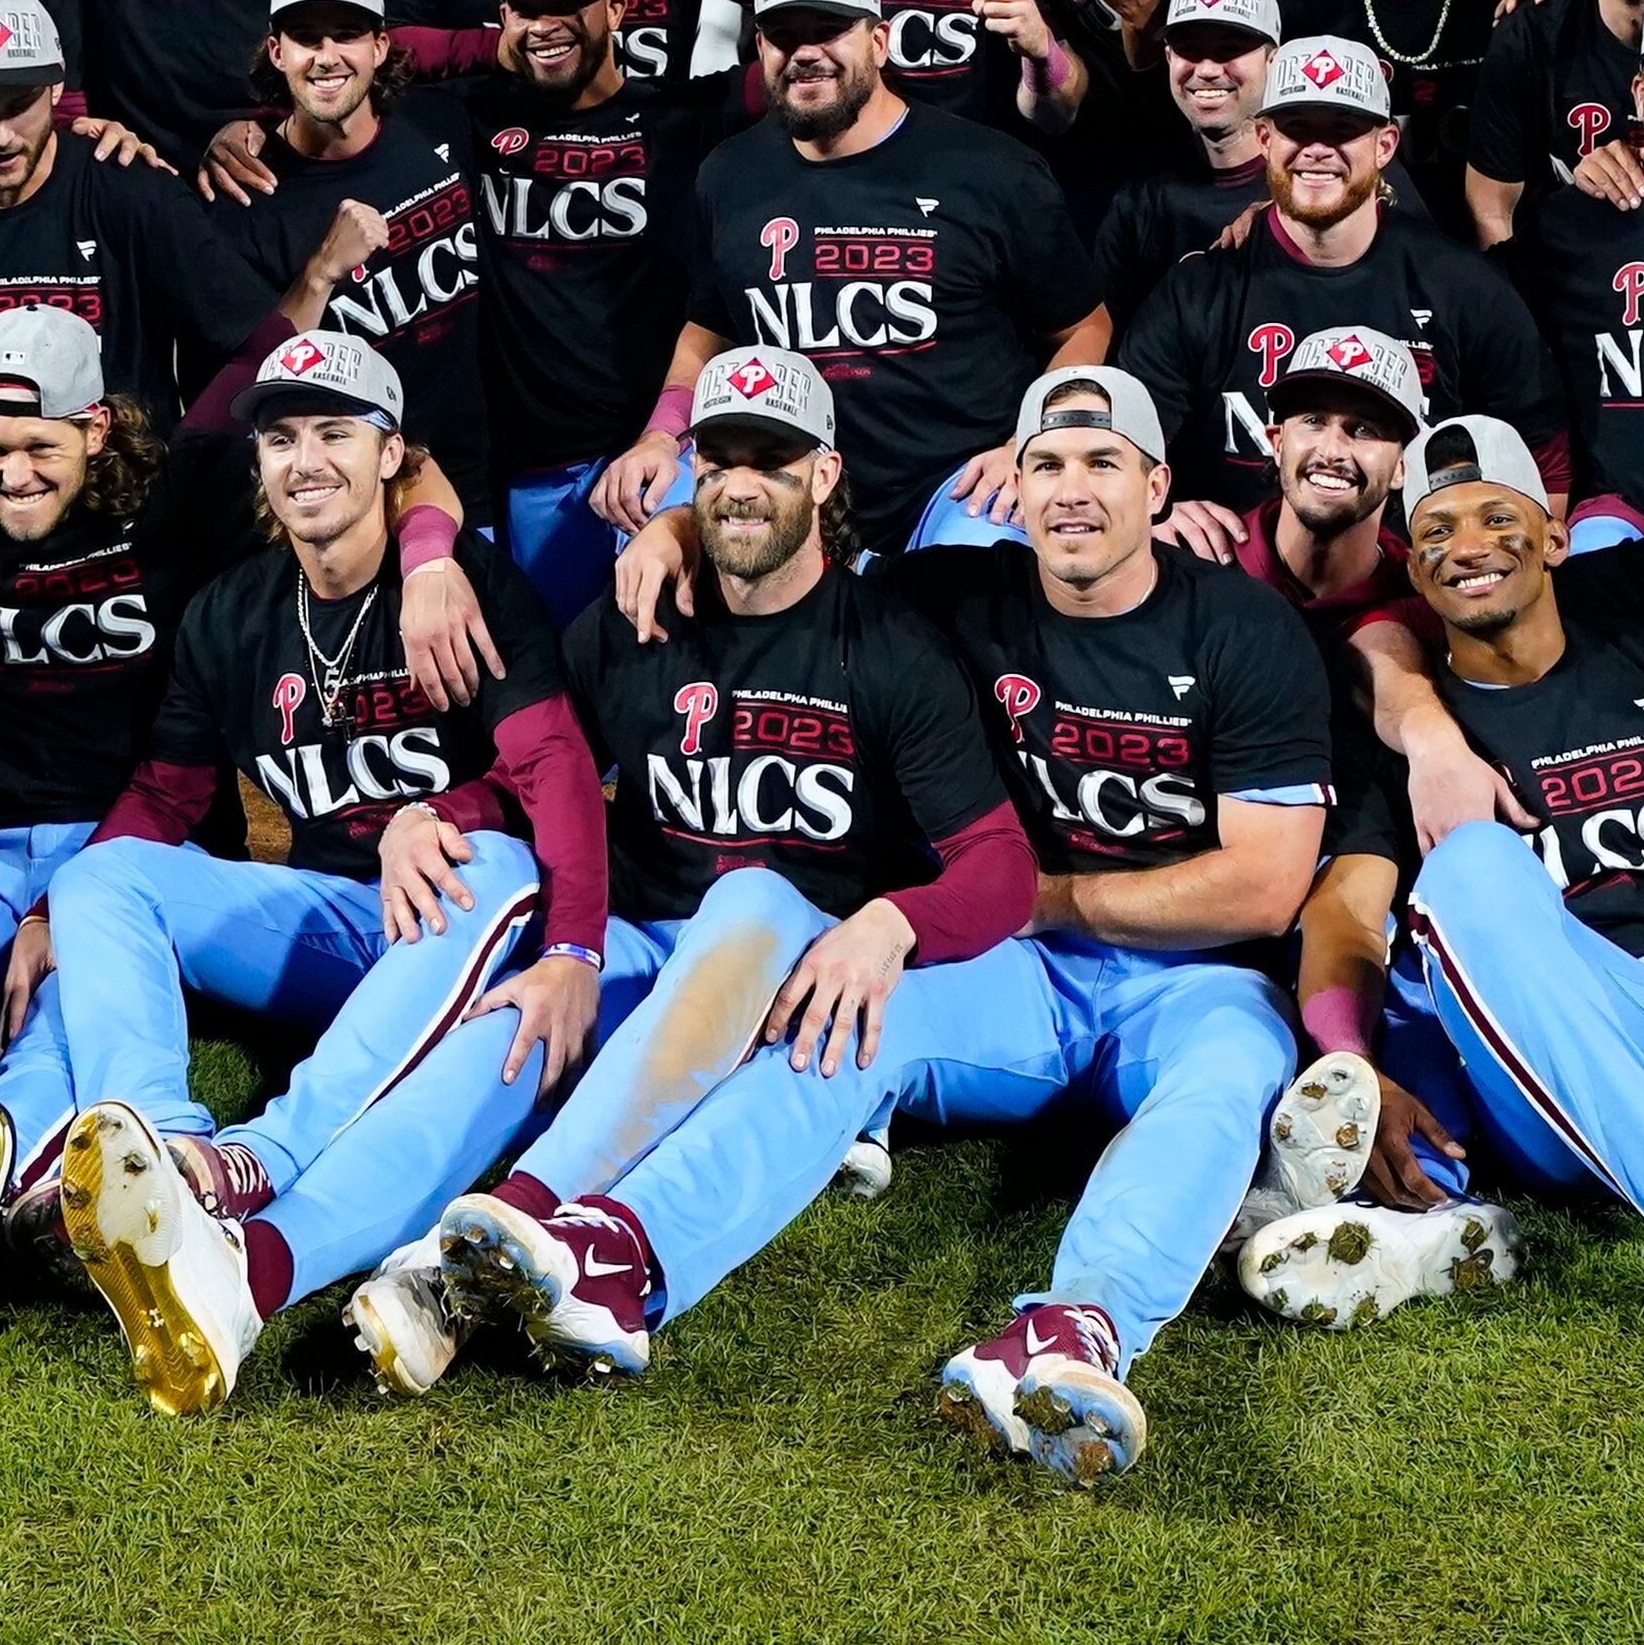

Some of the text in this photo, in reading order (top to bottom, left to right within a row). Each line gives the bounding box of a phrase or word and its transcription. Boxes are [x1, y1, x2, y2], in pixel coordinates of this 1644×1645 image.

[888, 9, 980, 69] CS
[534, 145, 647, 177] 2023
[1567, 102, 1612, 157] P
[480, 172, 647, 241] NLCS
[813, 225, 937, 239] PHILADELPHIA PHILLIES
[328, 221, 479, 337] NLCS
[760, 216, 800, 282] P
[813, 243, 935, 271] 2023
[744, 281, 938, 350] NLCS
[1248, 322, 1295, 387] P
[273, 672, 305, 745] P
[674, 681, 718, 756] P
[733, 710, 855, 755] 2023
[994, 673, 1042, 743] P
[1054, 699, 1193, 728] PHILADELPHIA PHILLIES
[255, 727, 451, 820] NLCS
[1051, 722, 1190, 766] 2023
[1530, 740, 1616, 771] PHILADELPHIA
[646, 754, 855, 841] NLCS
